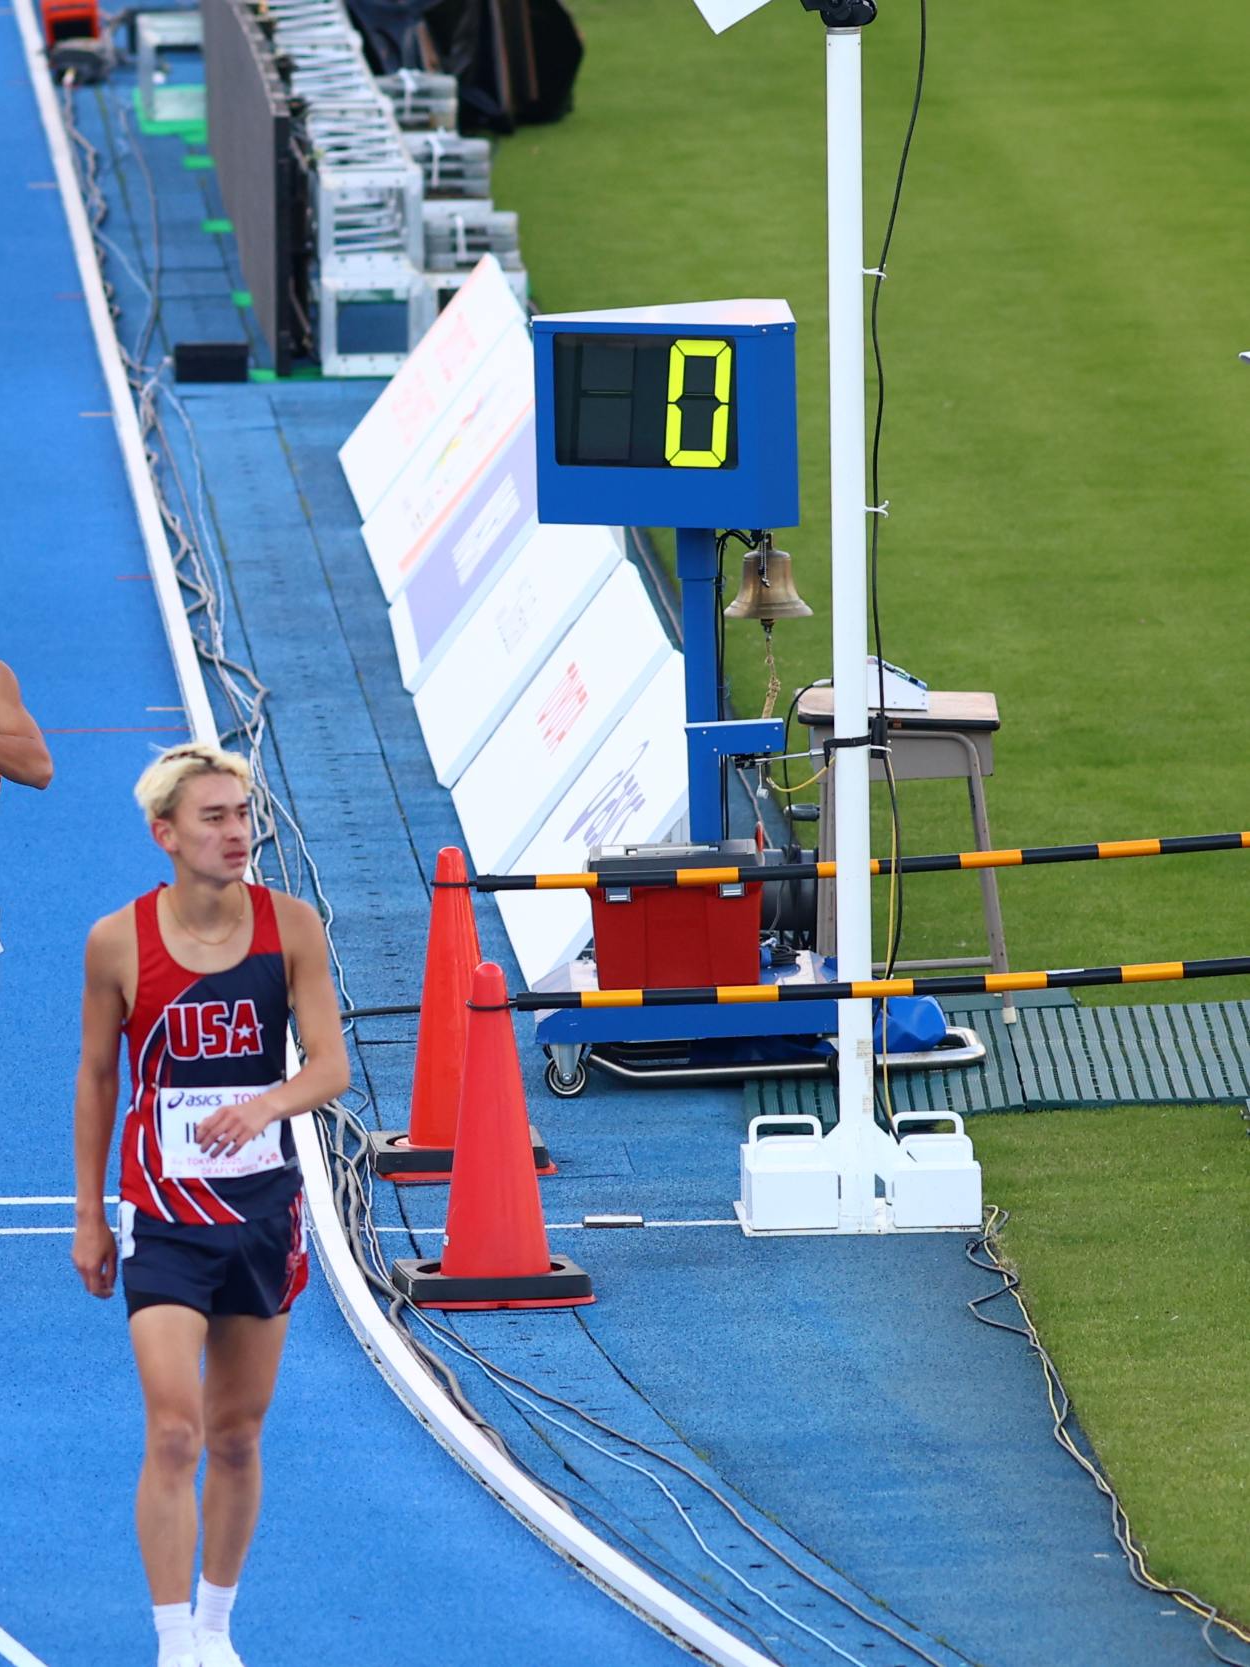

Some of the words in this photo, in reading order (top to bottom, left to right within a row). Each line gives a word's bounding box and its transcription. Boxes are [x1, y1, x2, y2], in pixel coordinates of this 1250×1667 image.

[665, 339, 732, 468] 0
[164, 999, 264, 1061] USA
[185, 1094, 222, 1107] asics
